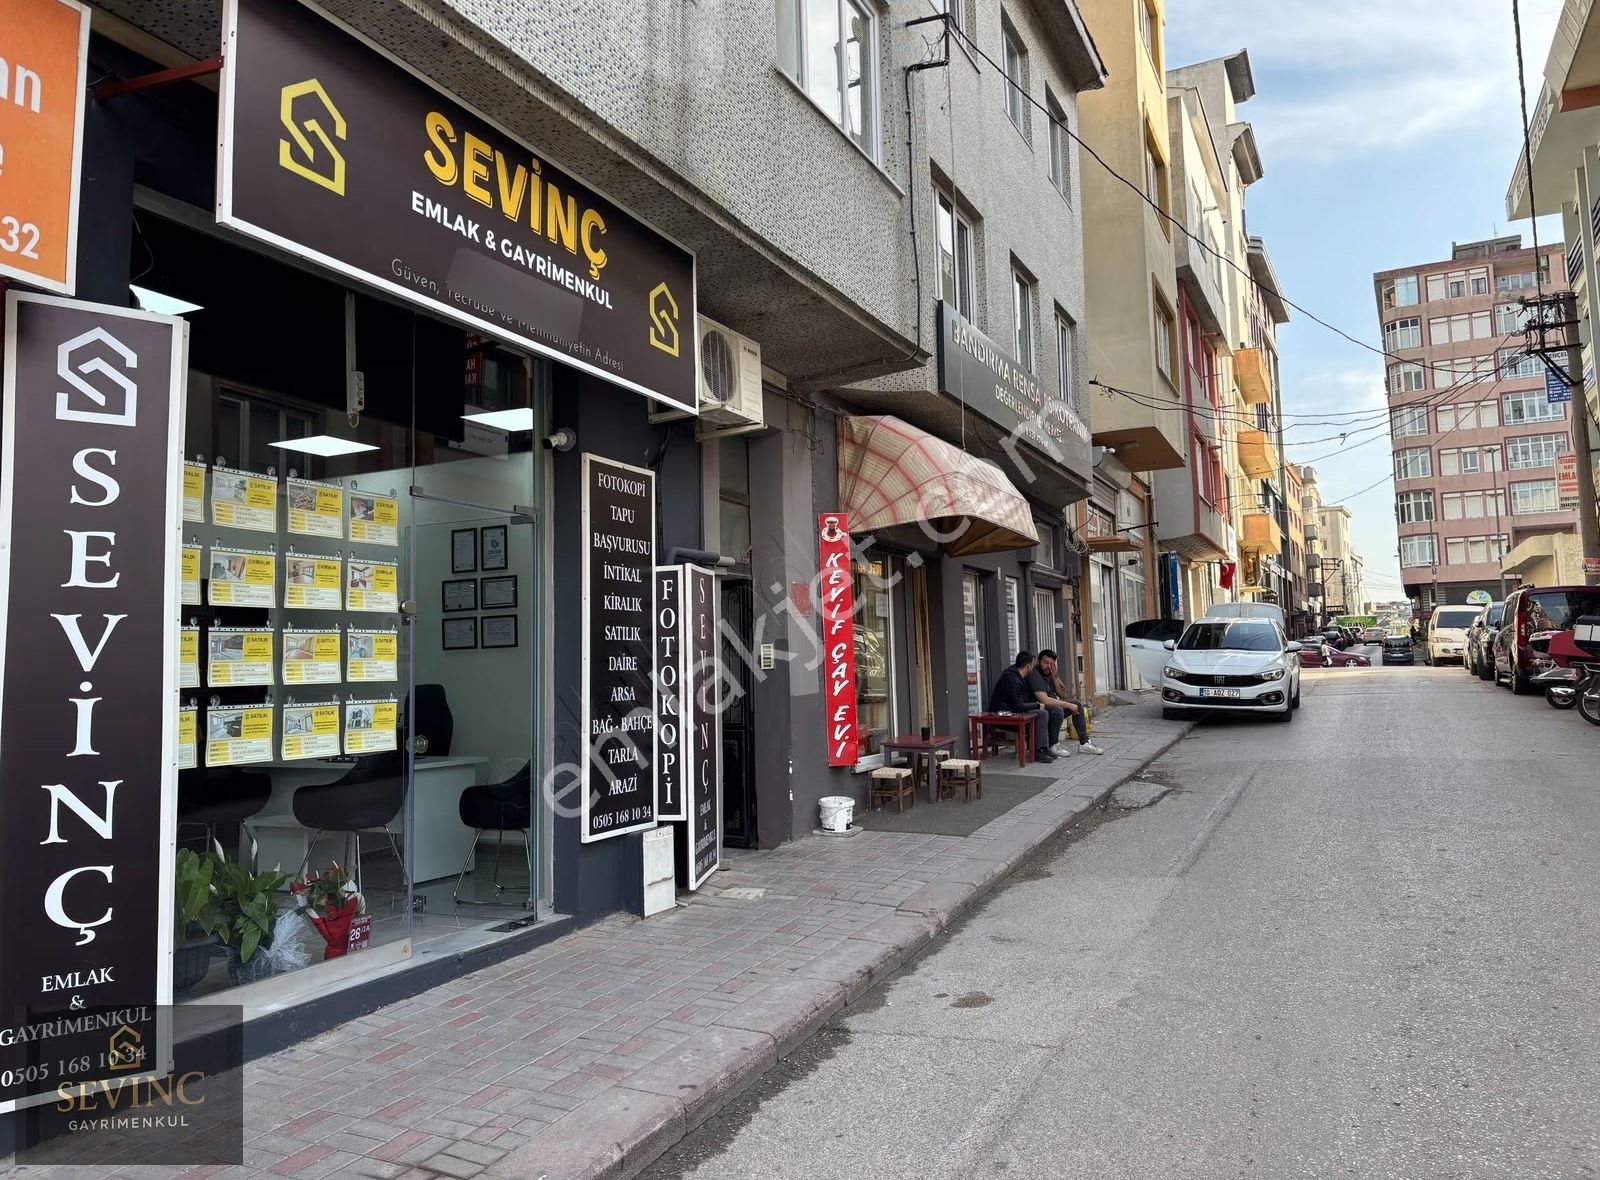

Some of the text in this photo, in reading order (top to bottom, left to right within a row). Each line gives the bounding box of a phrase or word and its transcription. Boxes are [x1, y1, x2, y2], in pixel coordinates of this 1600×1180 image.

[424, 111, 608, 281] SEVİNÇ
[0, 215, 40, 260] 32
[411, 190, 613, 310] EMLAK & GAYRİMENKUL
[391, 258, 440, 295] Güven,
[594, 348, 625, 371] Adresi
[952, 319, 1011, 384] BANDIRMA
[1013, 368, 1042, 407] RENSA
[597, 472, 647, 497] FOTOKOPİ
[609, 504, 636, 524] TAPU
[593, 532, 651, 556] BAŞVURUSU
[603, 561, 643, 583] İNTİKAL
[603, 592, 643, 612] KİRALIK
[604, 625, 642, 642] SATILIK
[608, 653, 638, 671] DAİRE
[831, 643, 850, 697] ÇAY
[40, 447, 129, 946] SEVİNÇ
[610, 686, 636, 702] ARSA
[659, 579, 677, 805] FOTOKOPİ
[592, 714, 614, 735] BAĞ
[621, 714, 652, 736] BAHÇE
[833, 705, 852, 759] EVİ
[607, 746, 639, 764] TARLA
[608, 772, 638, 796] ARAZİ
[592, 804, 652, 829] 0505 168 10 34
[40, 966, 116, 993] EMLAK
[69, 995, 88, 1012] &
[0, 1006, 152, 1047] GAYRİMENKUL
[0, 1044, 147, 1087] 0505 168 10 34
